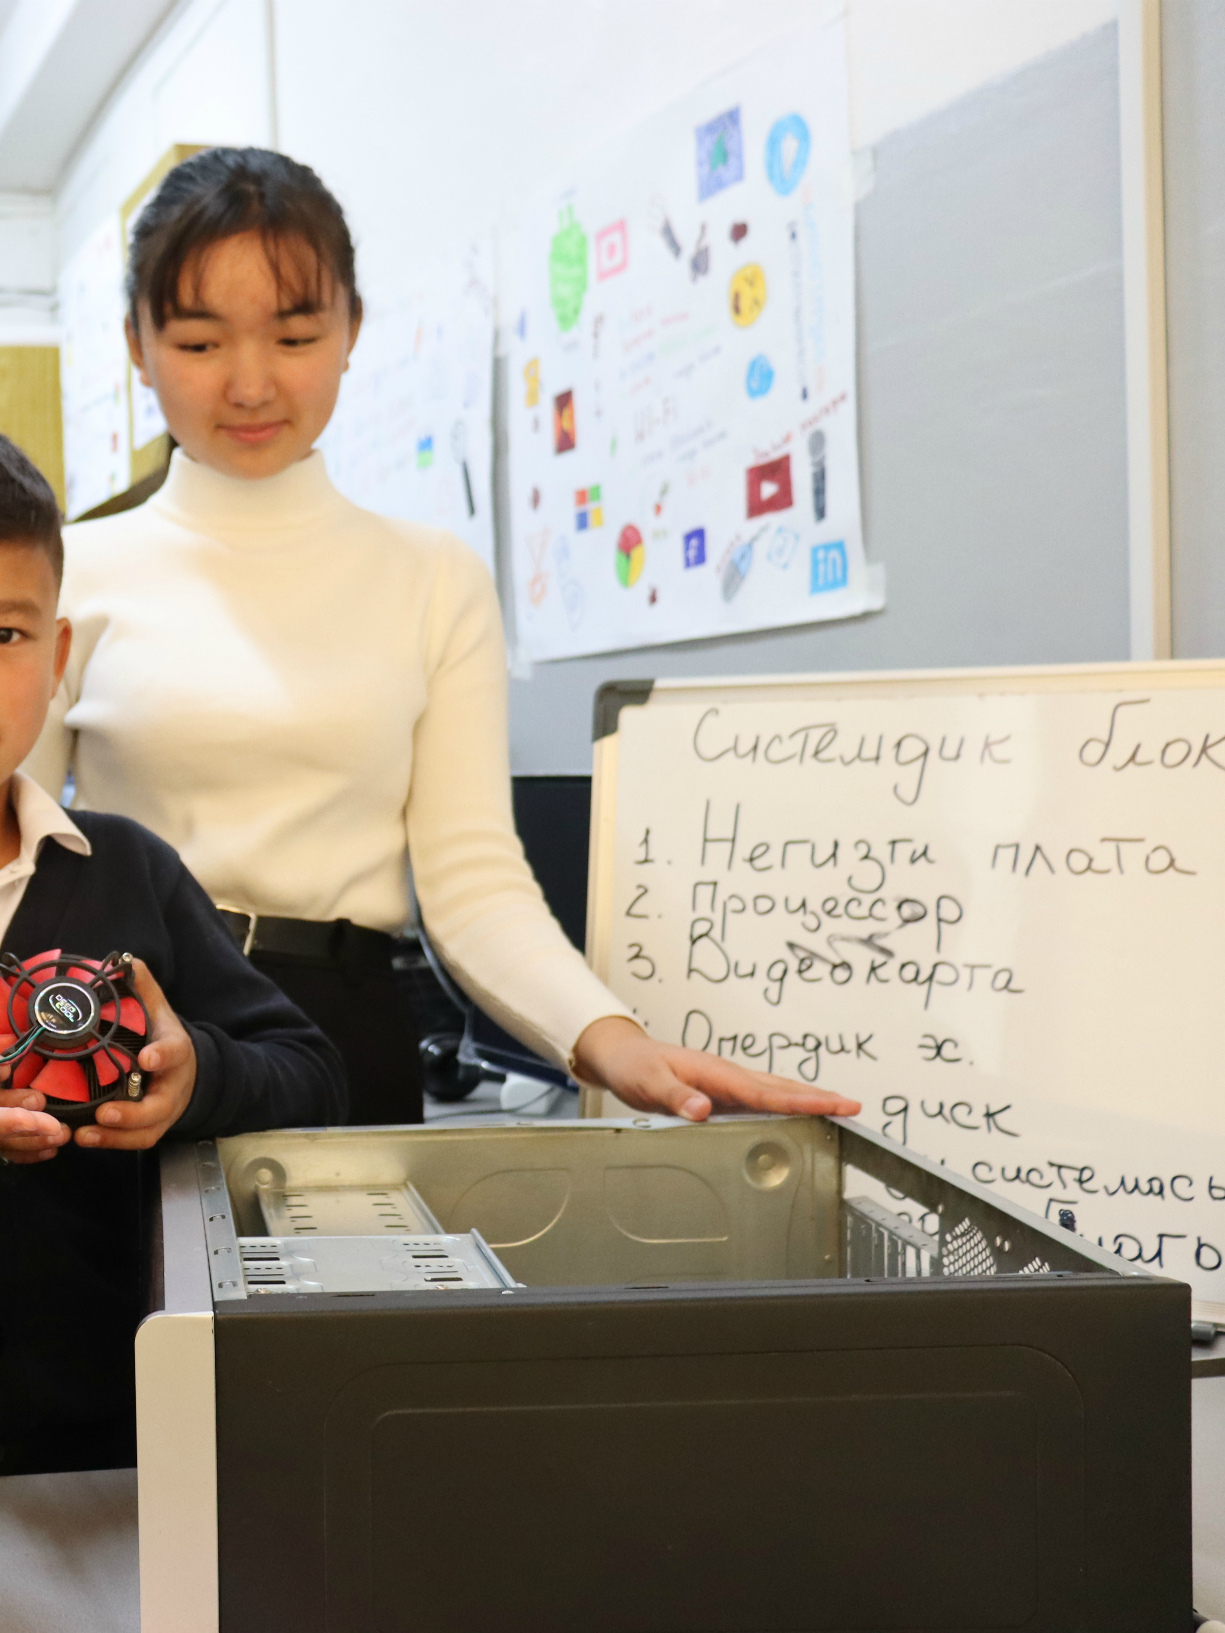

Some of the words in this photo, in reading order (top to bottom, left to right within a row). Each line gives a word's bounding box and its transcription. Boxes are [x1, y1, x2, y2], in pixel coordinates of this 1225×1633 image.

[693, 708, 1013, 806] Системдик
[1079, 698, 1225, 773] блок
[634, 827, 673, 865] 1.
[700, 800, 935, 893] Негизги
[991, 837, 1197, 878] плата
[624, 883, 663, 919] 2.
[691, 881, 964, 953] Процессор
[626, 942, 664, 981] 3.
[687, 918, 1025, 1010] Видеокарта
[55, 994, 77, 1013] DEEP
[56, 1002, 75, 1022] COOL
[882, 1094, 1021, 1147] диск
